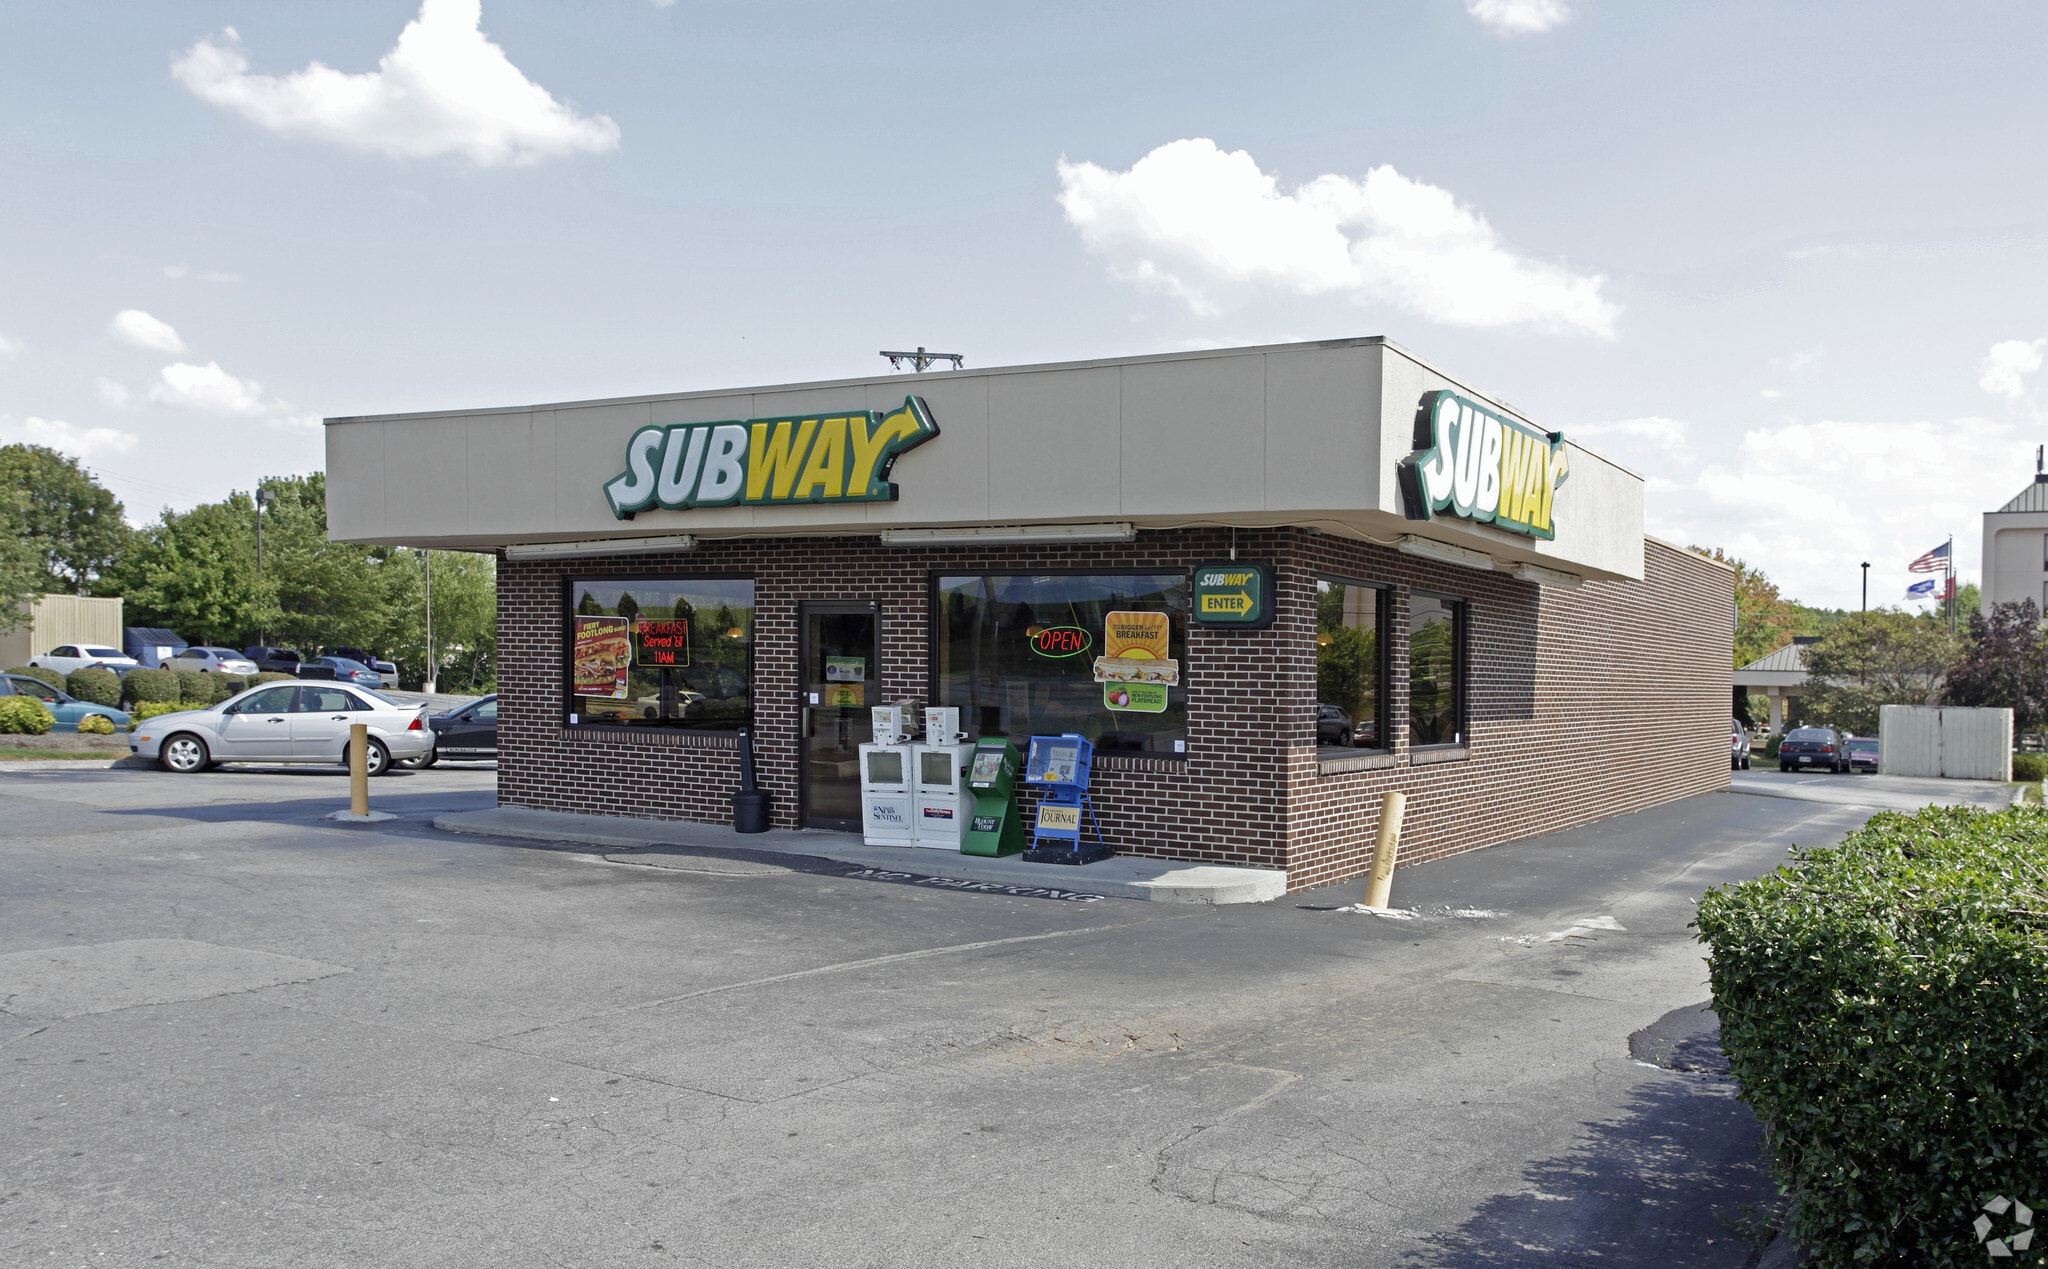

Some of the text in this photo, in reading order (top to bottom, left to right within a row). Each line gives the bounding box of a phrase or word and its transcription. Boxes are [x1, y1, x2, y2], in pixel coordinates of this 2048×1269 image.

[608, 405, 921, 509] SUBWAY
[1423, 397, 1569, 531] SUBWAY
[1200, 573, 1254, 587] SUBWAY
[1207, 598, 1244, 609] ENTER
[577, 625, 614, 640] FOOTLONG
[583, 621, 600, 631] FIERY
[639, 621, 687, 635] BREAKFAST
[643, 636, 672, 647] Served
[1040, 631, 1083, 651] OPEN
[1116, 631, 1159, 639] BREAKFAST
[654, 651, 675, 664] 11AM
[878, 806, 895, 814] NEWS
[1040, 808, 1076, 824] JOURNAL
[845, 869, 1105, 903] NO PARKING
